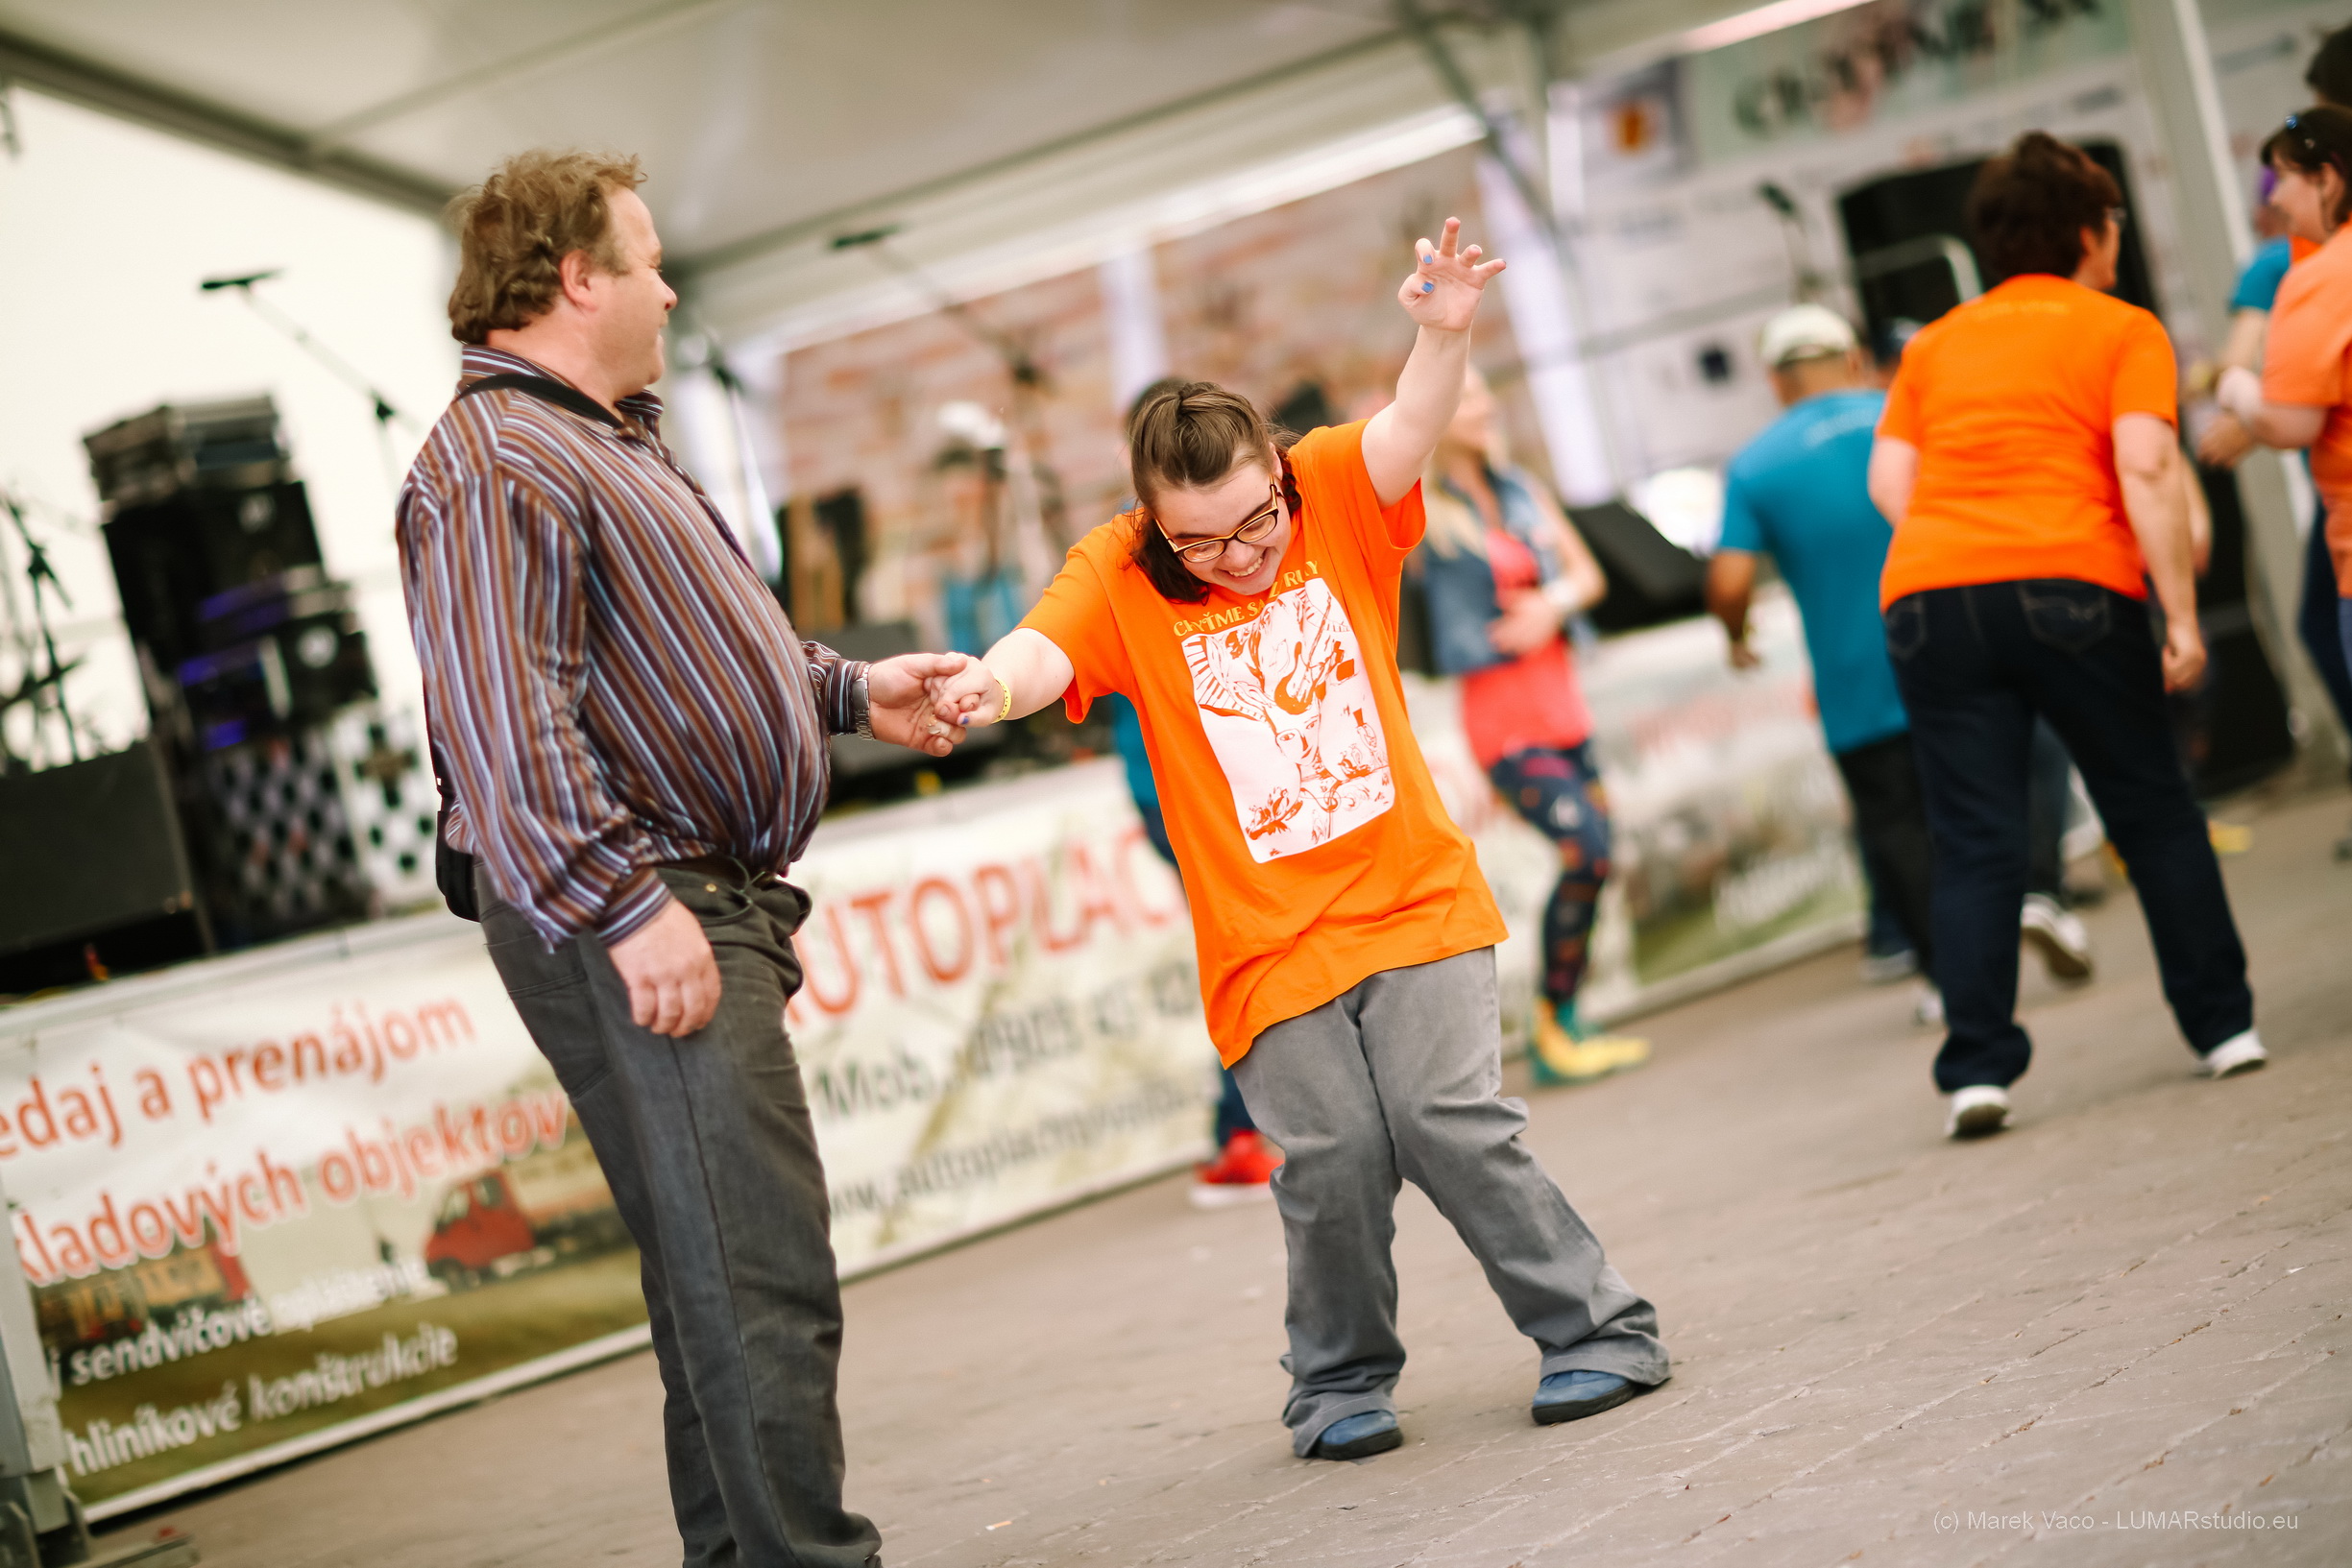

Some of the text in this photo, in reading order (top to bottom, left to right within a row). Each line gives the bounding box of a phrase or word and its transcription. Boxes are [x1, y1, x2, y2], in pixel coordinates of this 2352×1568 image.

[785, 824, 1188, 1027] UTOPLAC
[137, 1062, 172, 1119] a
[186, 998, 477, 1126] prenájom
[320, 1090, 567, 1202] objektov
